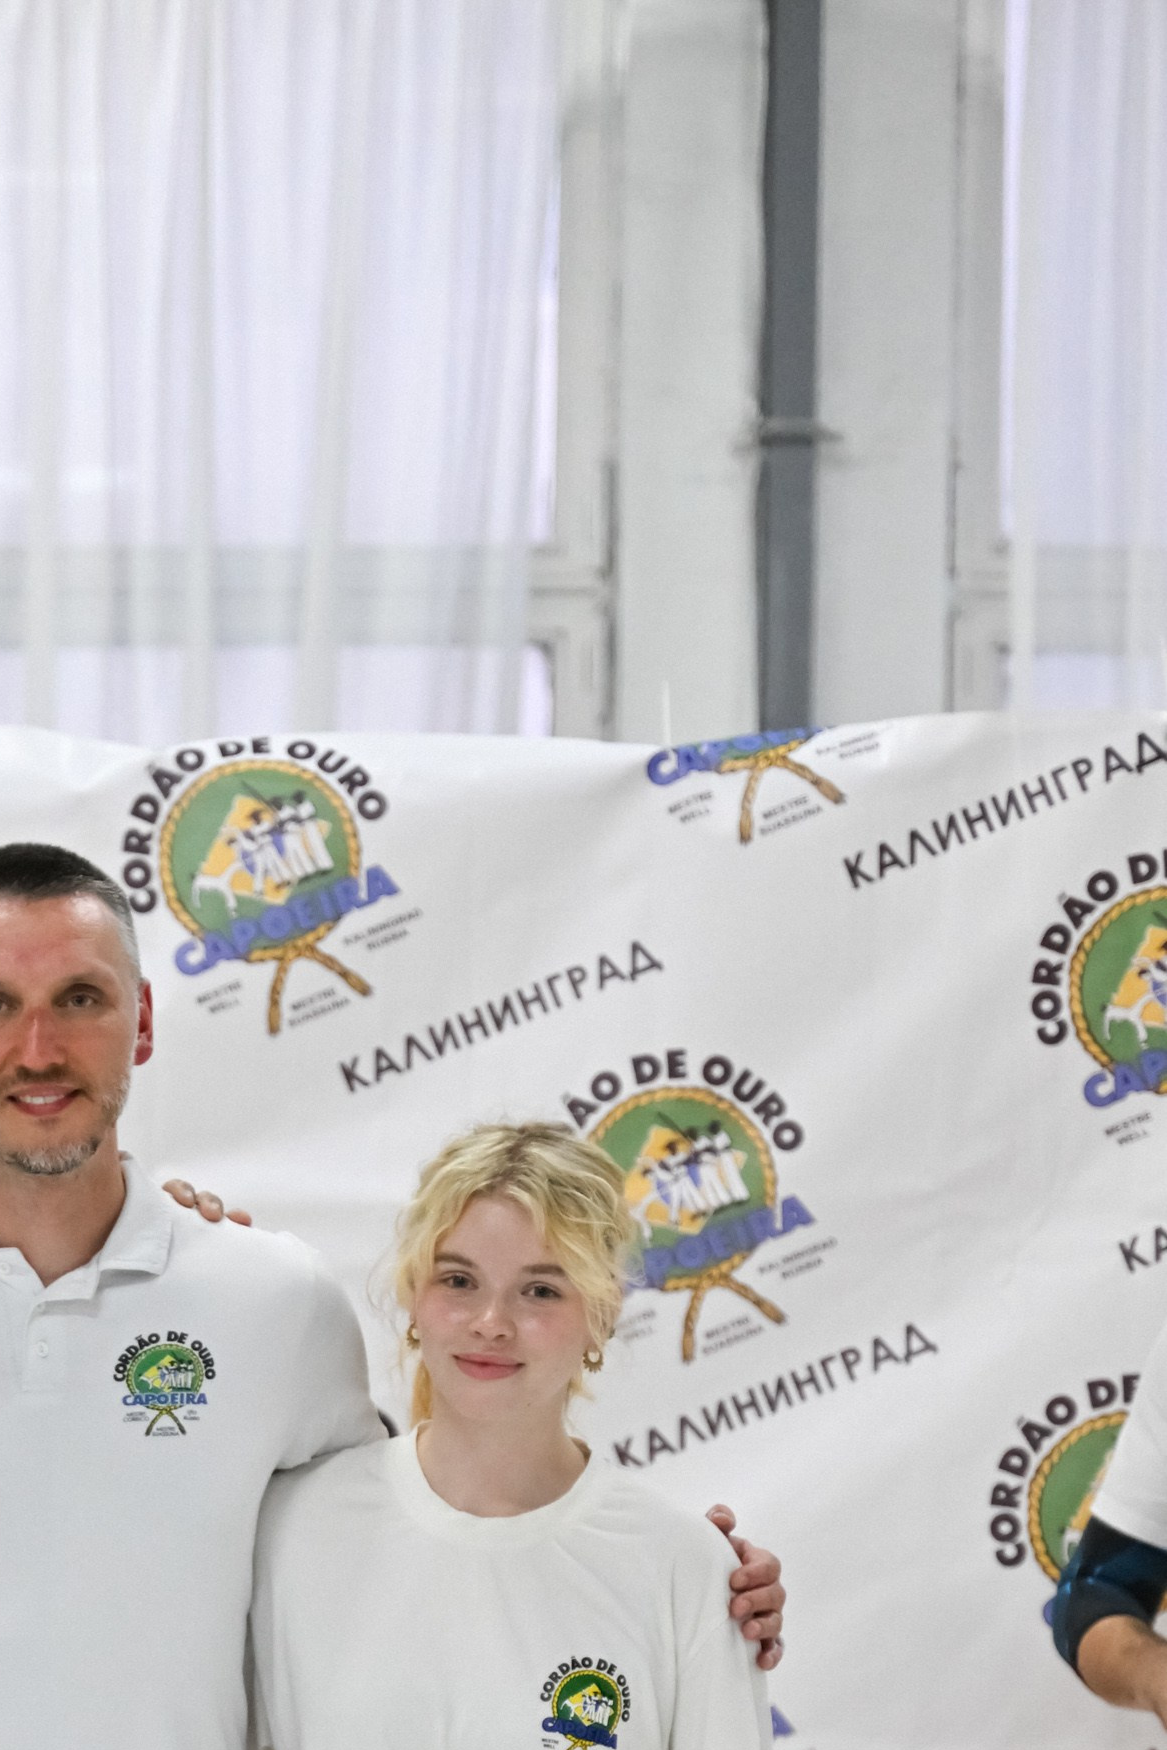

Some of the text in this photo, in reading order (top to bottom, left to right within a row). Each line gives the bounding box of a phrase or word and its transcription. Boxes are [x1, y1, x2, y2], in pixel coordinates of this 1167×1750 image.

[123, 736, 387, 914] CORDÃO DE OURO
[842, 732, 1167, 889] КАЛИНИНГРАД
[175, 864, 400, 976] CAPOEIRA
[1031, 869, 1119, 1045] CORDÃO
[339, 940, 664, 1094] КАЛИНИНГРАД
[632, 1048, 687, 1085] DE
[701, 1054, 805, 1152] OURO
[113, 1331, 216, 1382] CORDÃO DE OURO
[122, 1392, 208, 1406] CAPOEIRA
[613, 1322, 939, 1469] КАЛИНИНГРАД
[990, 1395, 1077, 1569] CORDÃO
[540, 1656, 632, 1723] CORDÃO DE OURO
